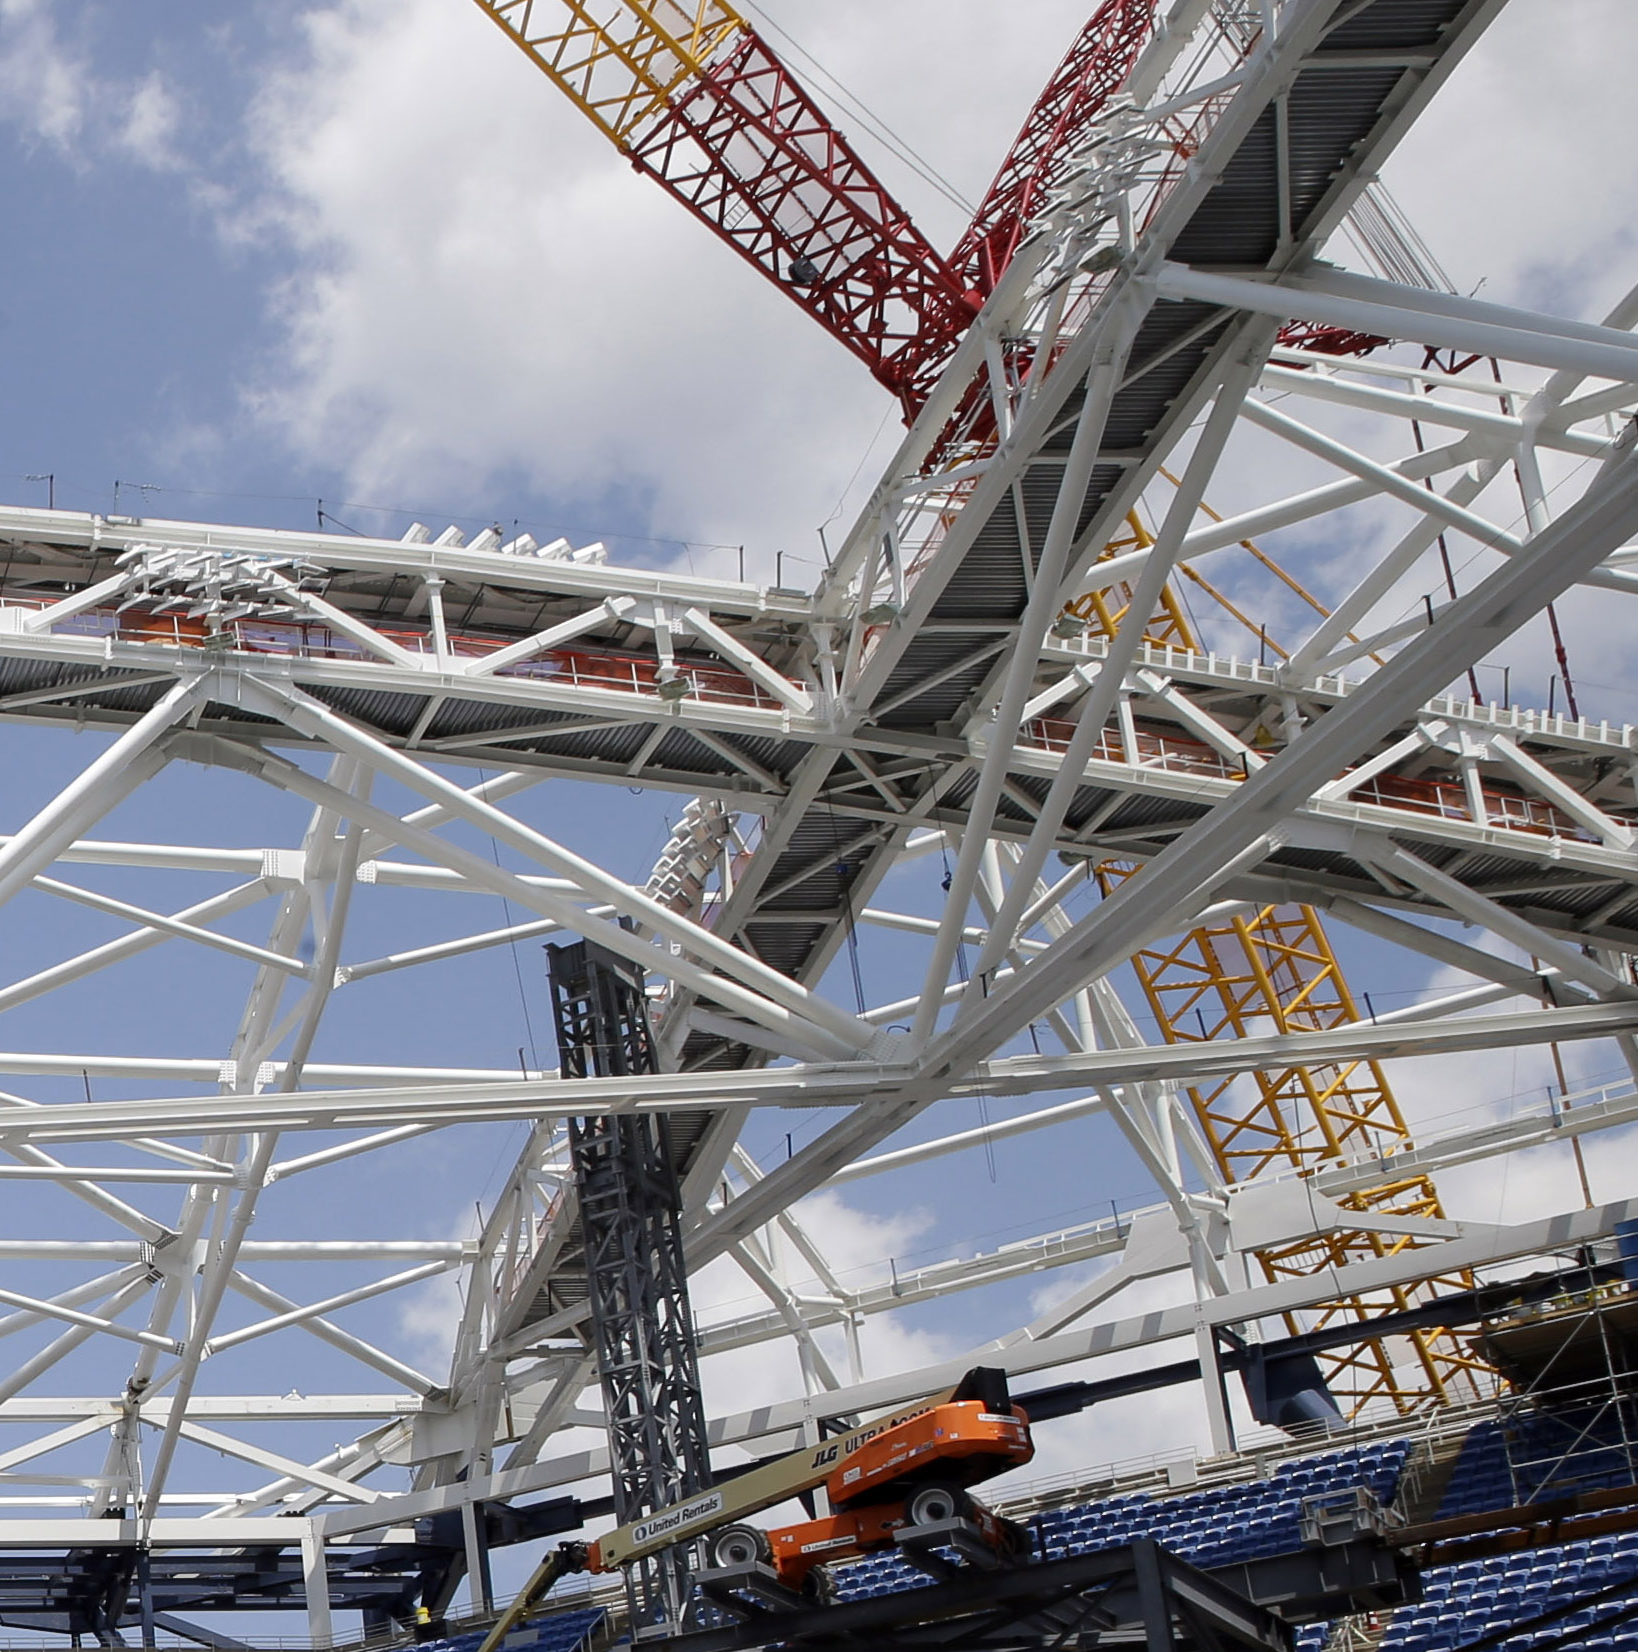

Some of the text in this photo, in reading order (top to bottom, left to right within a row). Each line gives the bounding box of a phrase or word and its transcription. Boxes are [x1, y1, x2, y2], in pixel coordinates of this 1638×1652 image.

[812, 1445, 838, 1469] JLG
[648, 1498, 718, 1536] United Rentals
